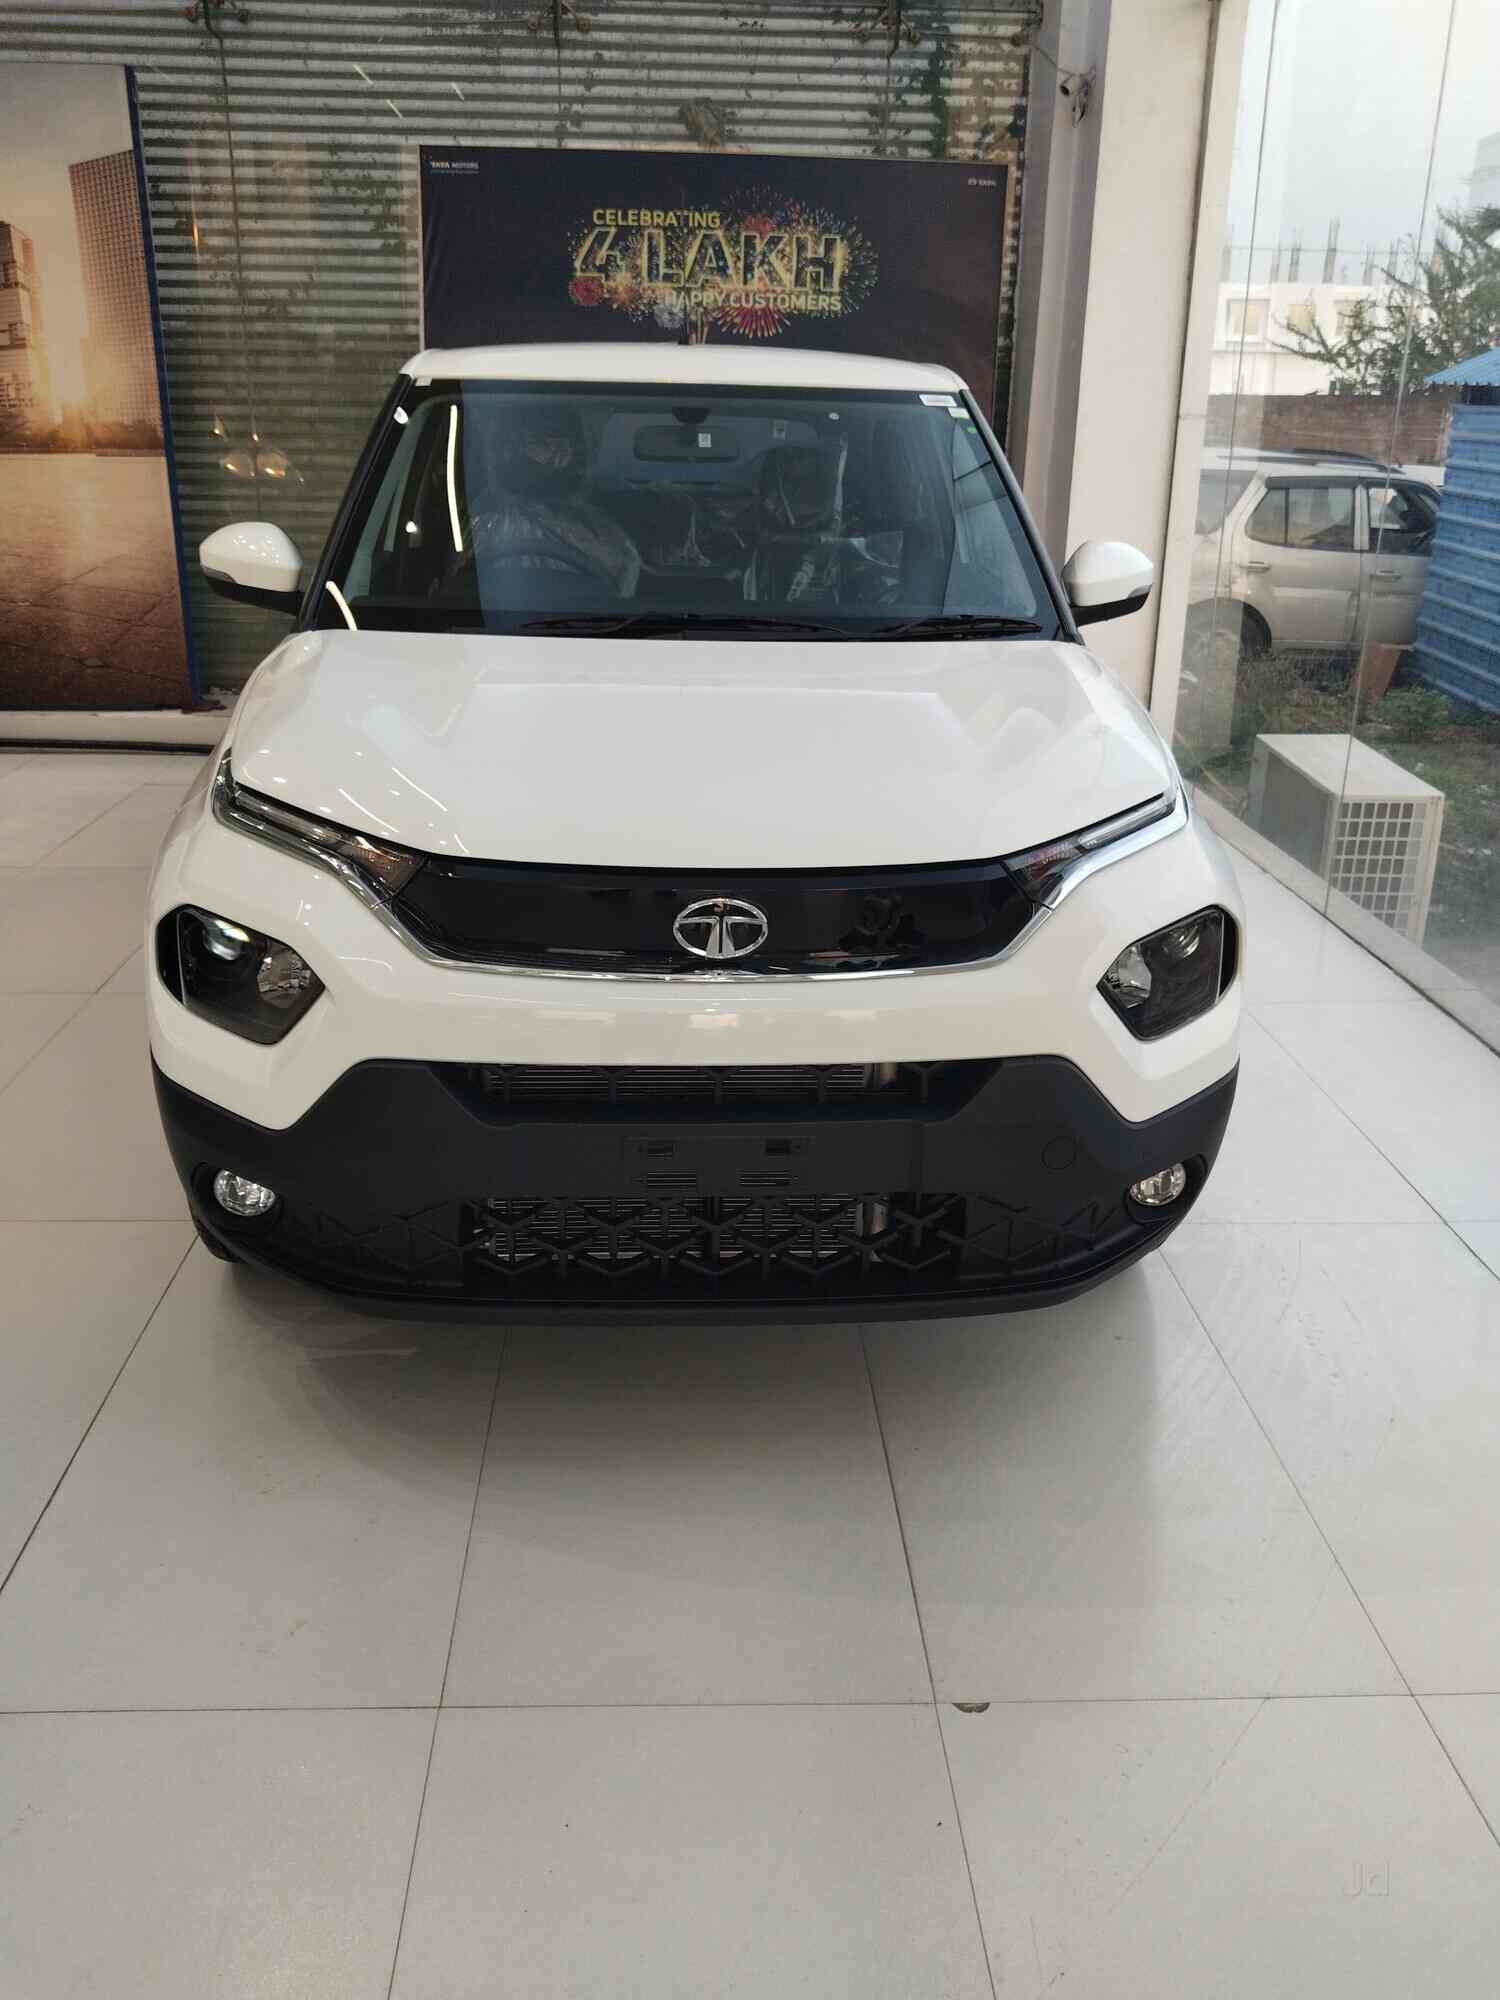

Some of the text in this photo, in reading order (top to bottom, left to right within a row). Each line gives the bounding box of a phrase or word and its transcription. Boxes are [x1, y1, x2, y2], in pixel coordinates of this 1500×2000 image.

[430, 161, 450, 169] TATA
[592, 208, 722, 228] CELEBRATING
[573, 225, 843, 294] 4 LAKH
[664, 288, 842, 312] HAPPY CUSTOMERS
